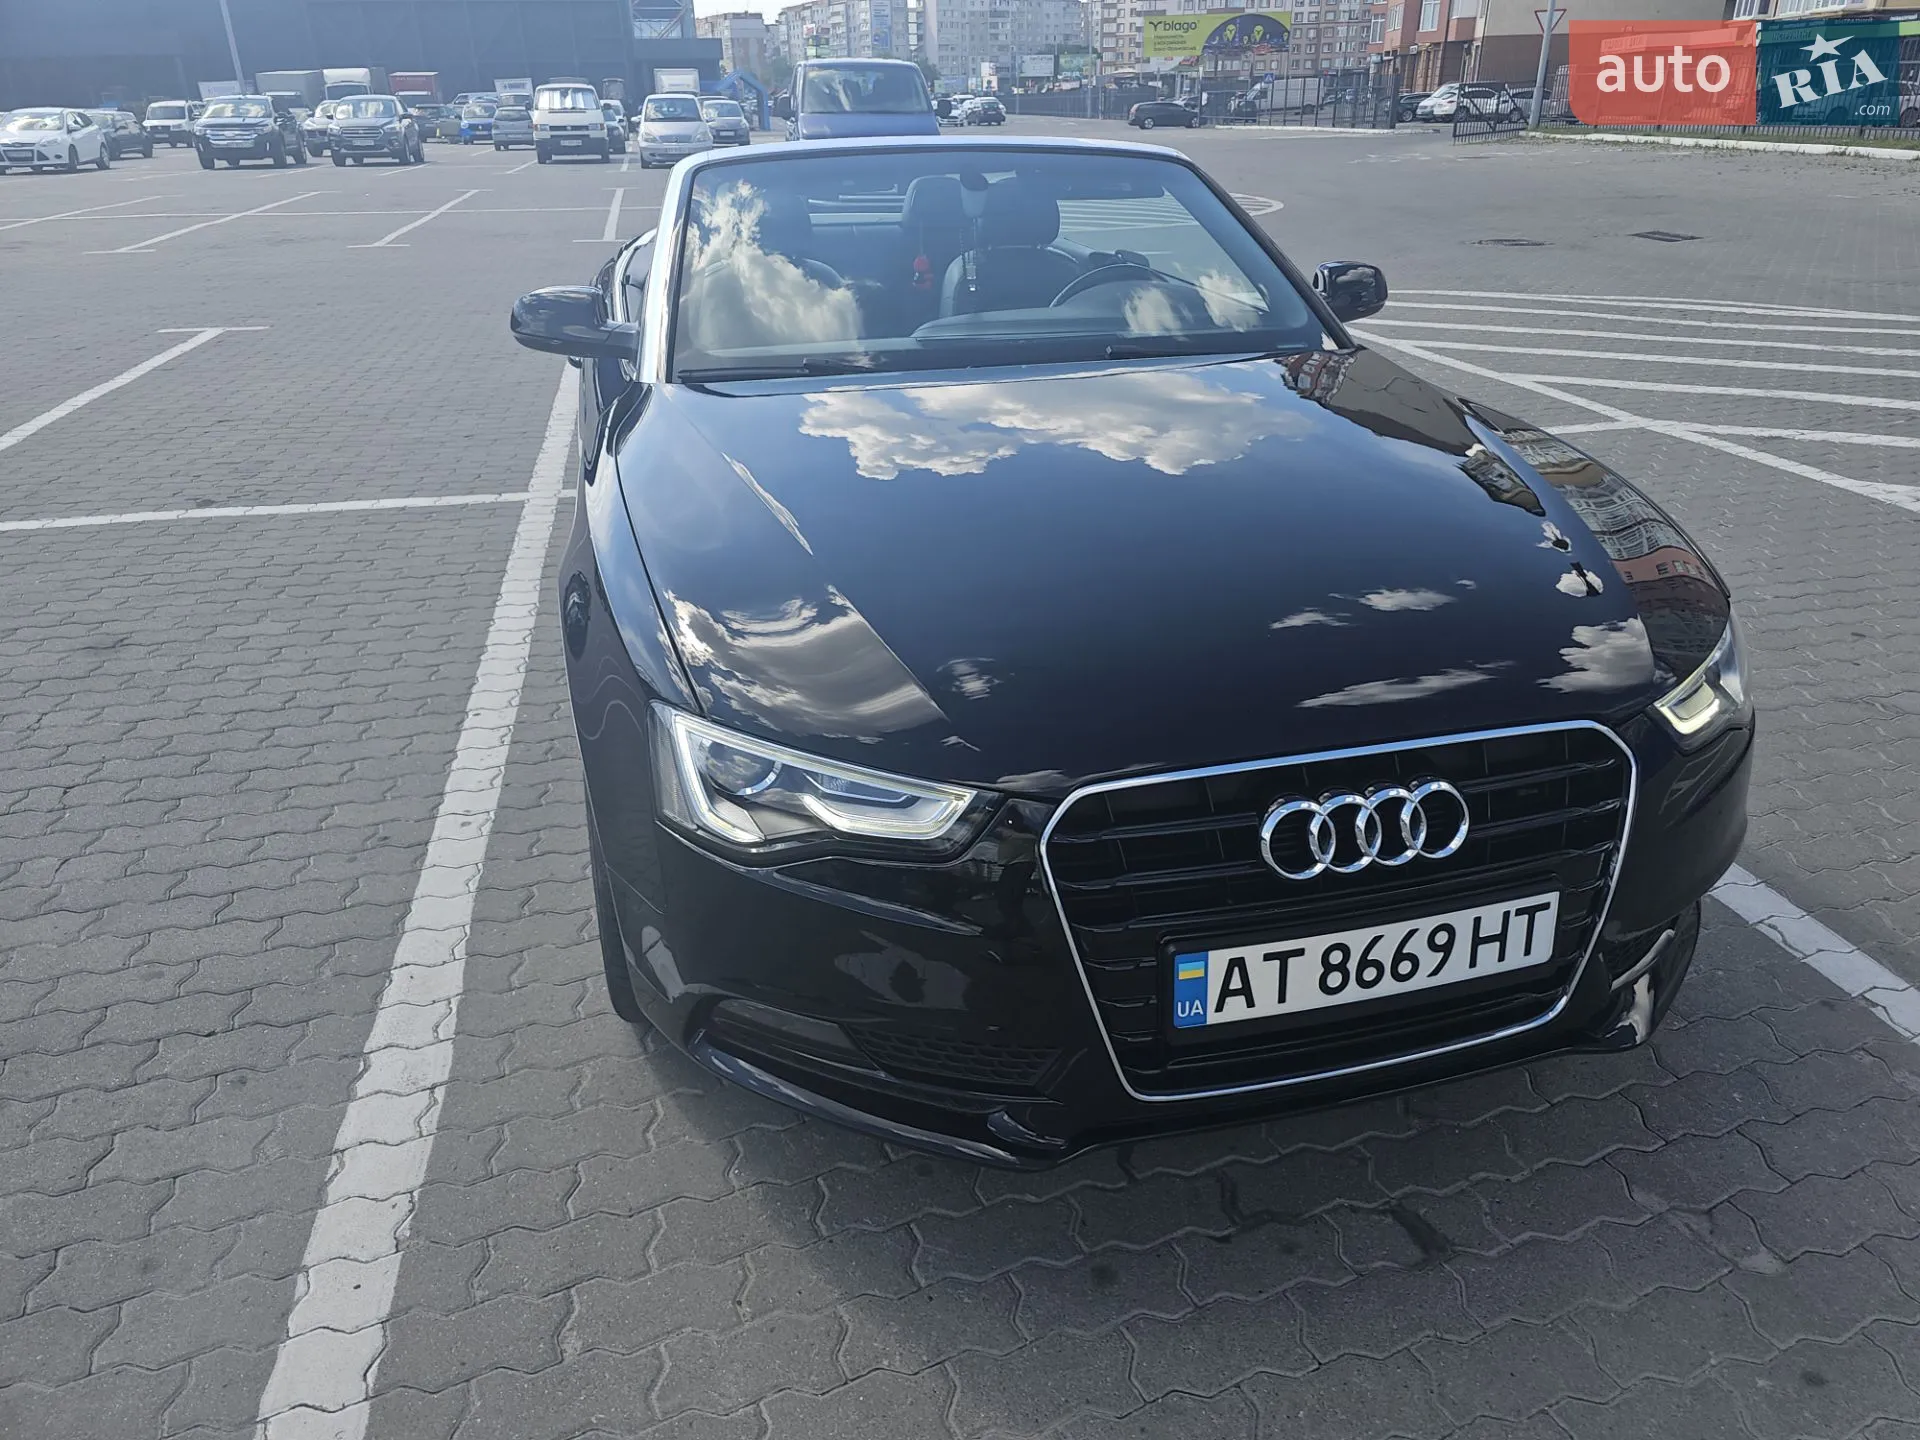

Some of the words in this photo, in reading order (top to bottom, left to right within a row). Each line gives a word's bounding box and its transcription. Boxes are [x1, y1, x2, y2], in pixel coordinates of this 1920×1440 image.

[1163, 20, 1197, 34] blago
[1213, 947, 1305, 1013] AT
[1318, 923, 1457, 996] 8669
[1177, 1000, 1204, 1019] UA
